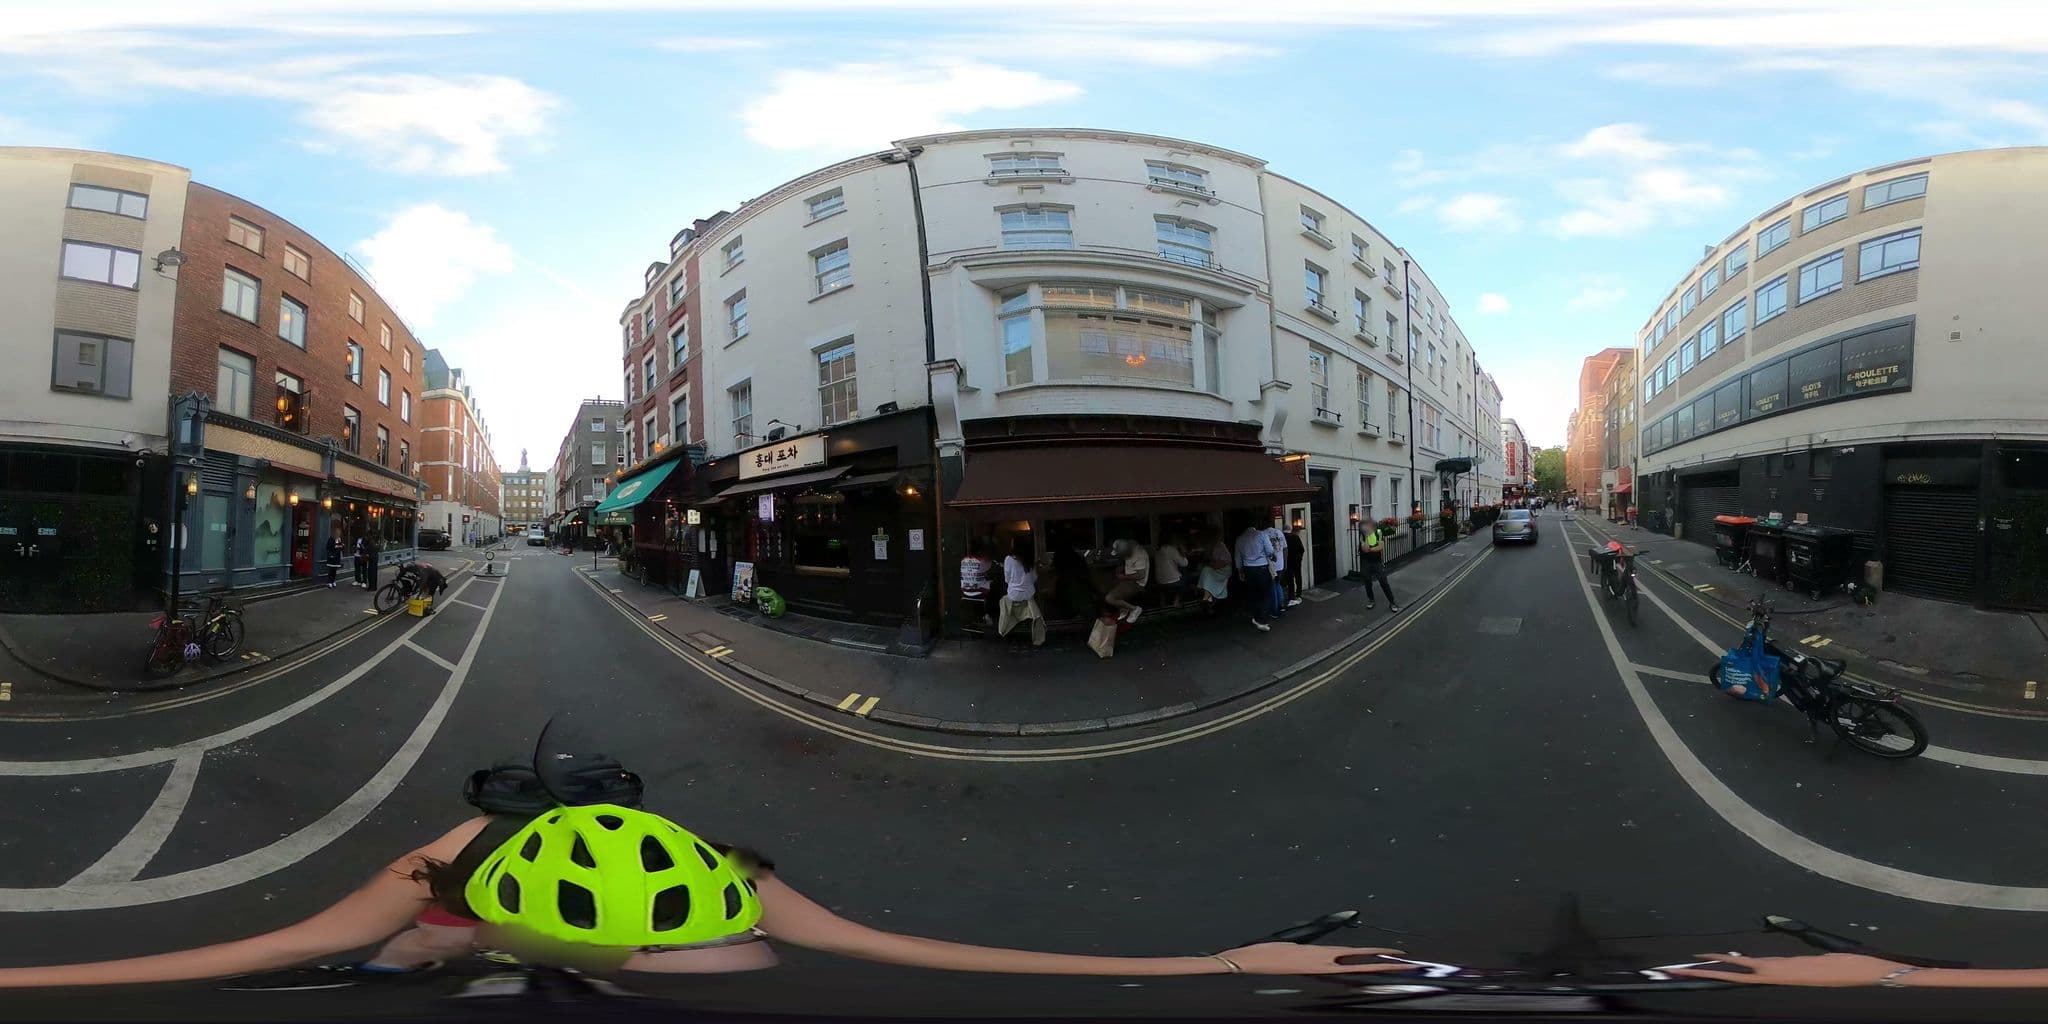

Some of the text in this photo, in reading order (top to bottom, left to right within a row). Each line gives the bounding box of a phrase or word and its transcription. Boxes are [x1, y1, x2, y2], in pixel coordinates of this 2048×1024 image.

[1846, 365, 1899, 381] E-ROULETTE
[1801, 381, 1823, 393] SLOTS
[755, 450, 773, 468] 홍대
[776, 444, 798, 461] 포차
